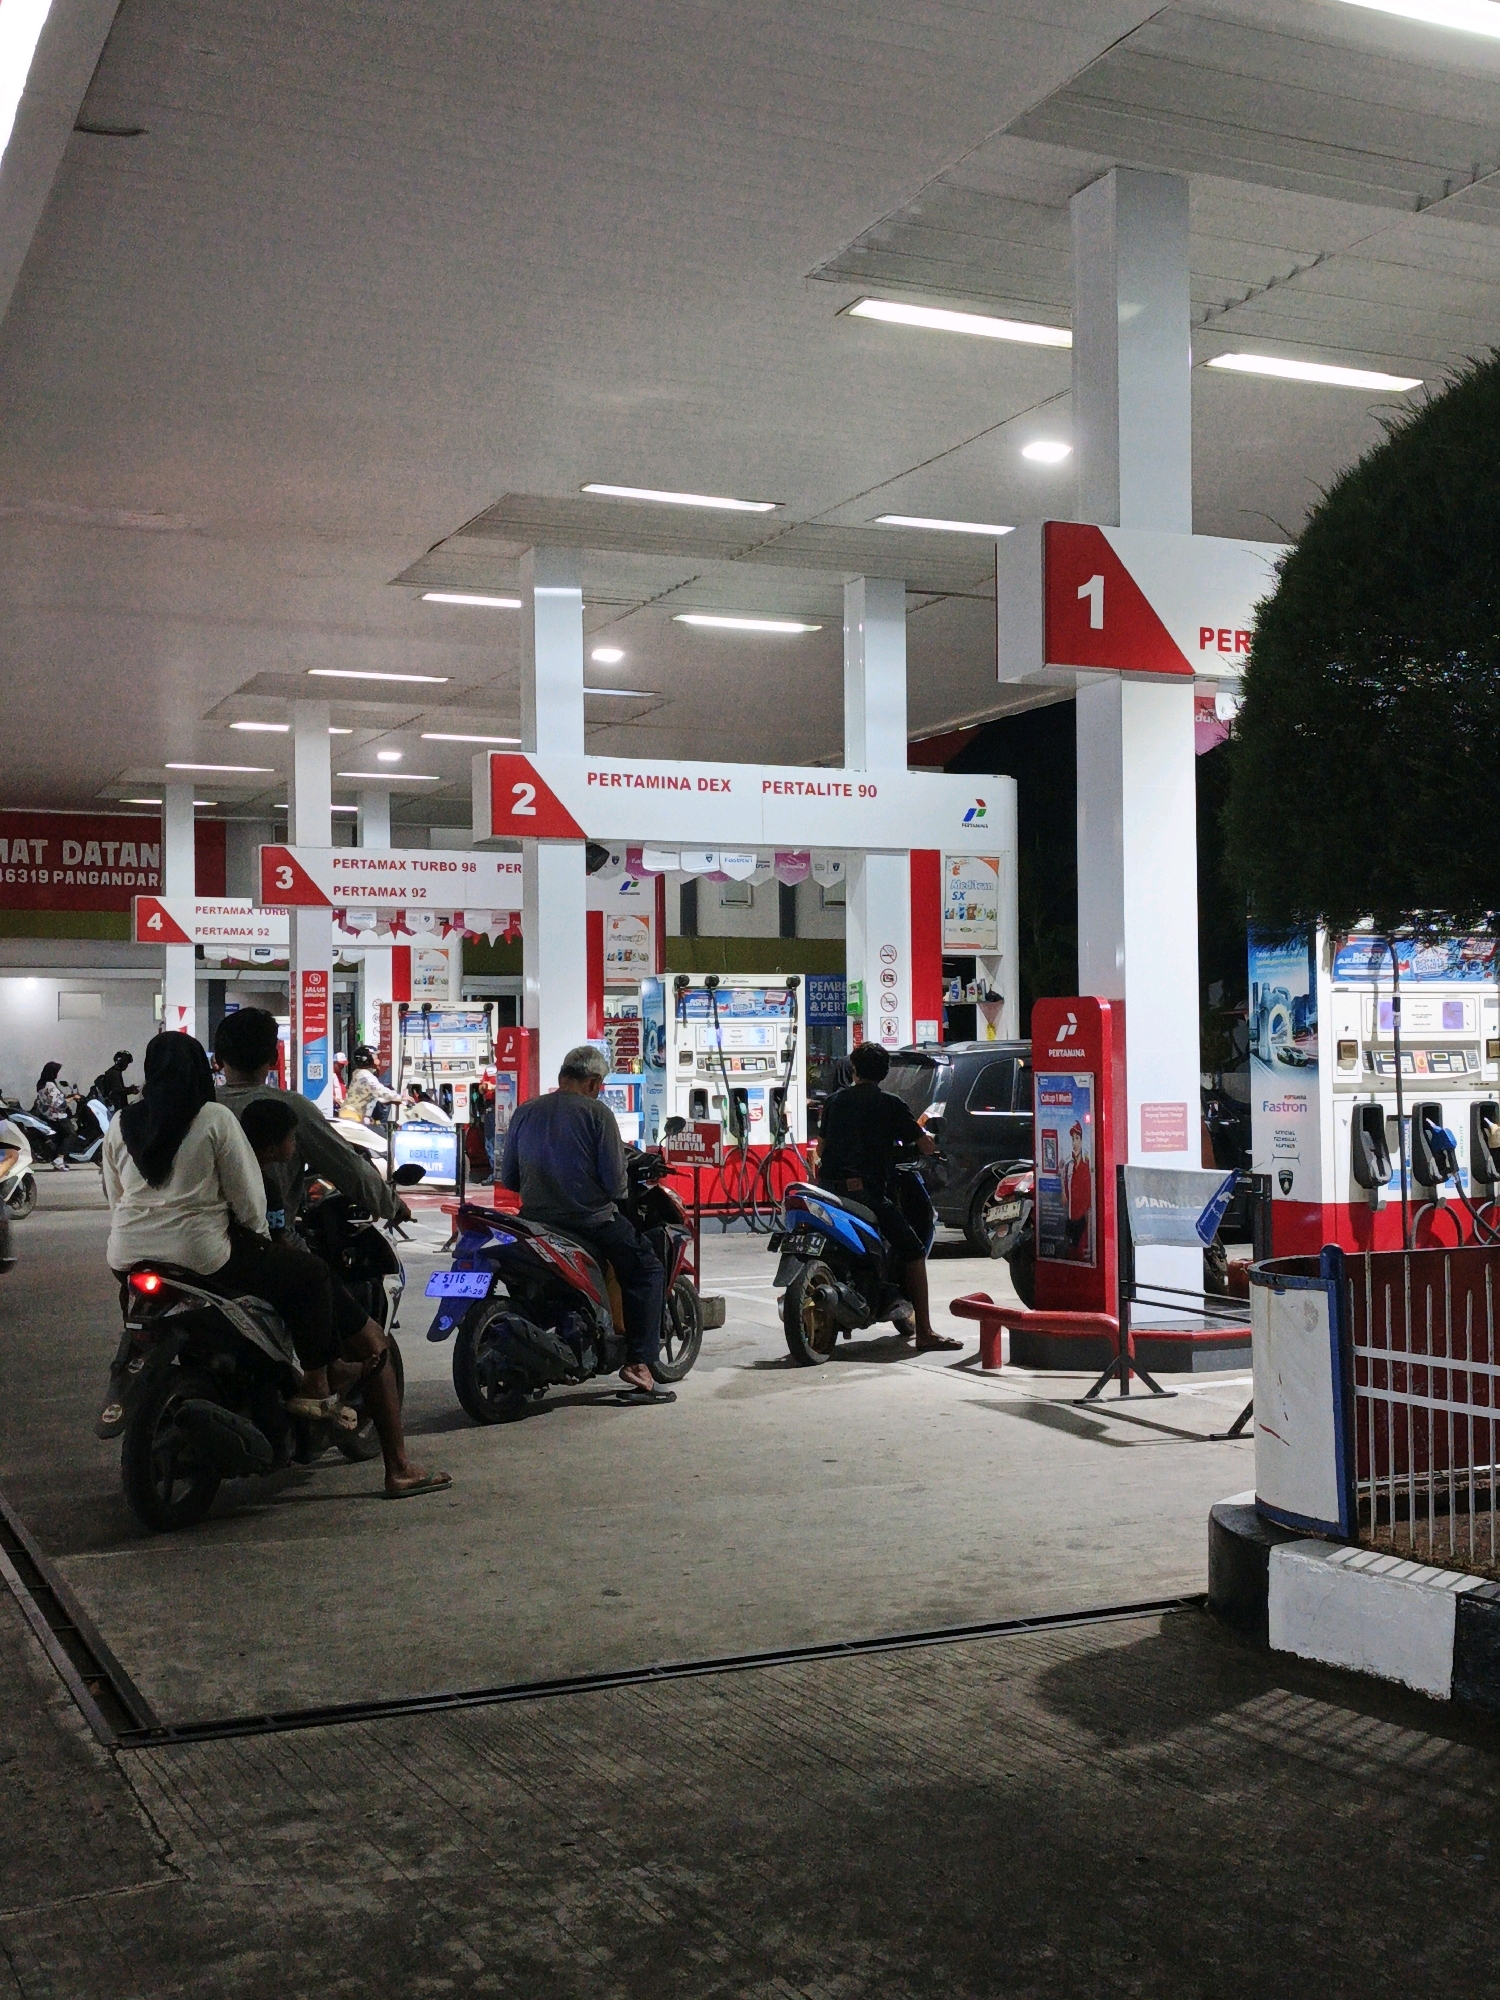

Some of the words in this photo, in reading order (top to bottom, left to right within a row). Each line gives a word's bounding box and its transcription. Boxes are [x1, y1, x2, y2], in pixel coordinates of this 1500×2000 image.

[1077, 574, 1105, 630] 1
[1199, 626, 1252, 653] PER
[587, 772, 691, 791] PERTAMINA
[697, 777, 732, 792] DEX
[762, 780, 853, 797] PERTALITE
[858, 783, 878, 798] 90
[511, 782, 537, 816] 2
[333, 858, 407, 871] PERTAMAX
[412, 861, 457, 872] TURBO
[461, 863, 477, 873] 98
[497, 863, 522, 874] PER
[53, 870, 162, 887] PANGANDAR
[275, 865, 294, 890] 3
[333, 885, 407, 898] PERTAMAX
[411, 888, 427, 898] 92
[195, 905, 254, 916] PERTAMAX
[259, 908, 290, 916] TURB
[147, 912, 163, 931] 4
[195, 926, 254, 936] PERTAMAX
[257, 927, 270, 937] 92
[1048, 1048, 1086, 1058] PERTAMINA
[1262, 1100, 1308, 1113] Fastron
[430, 1273, 440, 1284] Z
[442, 1273, 467, 1284] 5116
